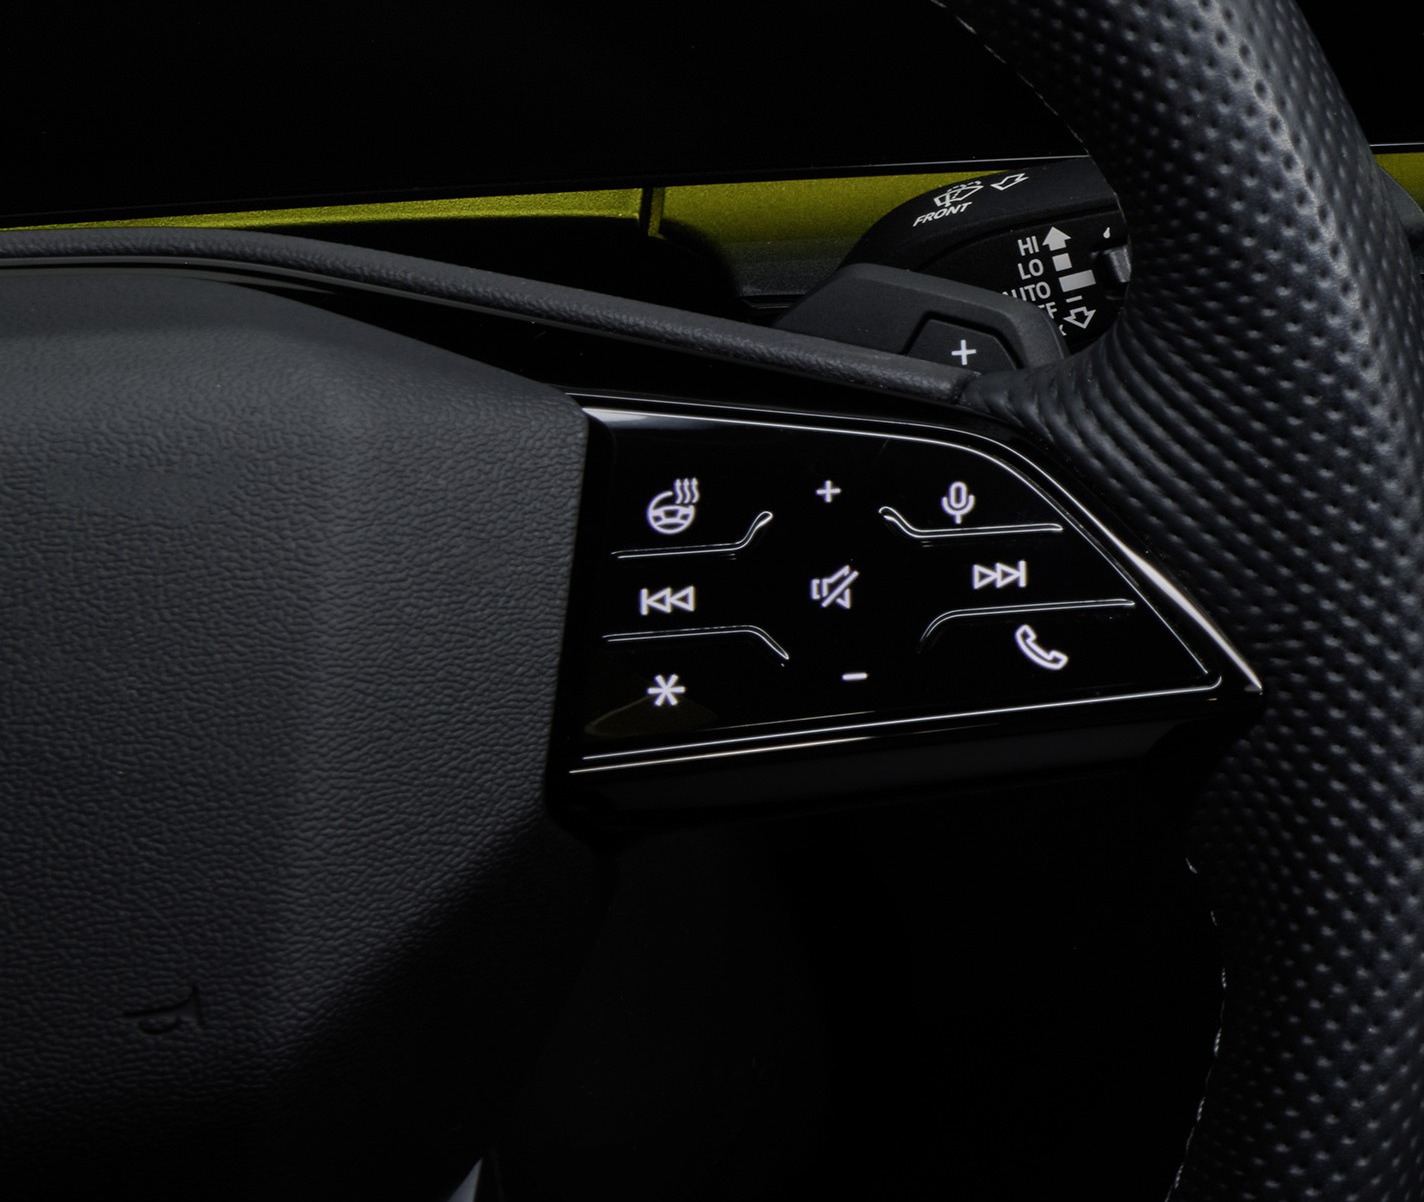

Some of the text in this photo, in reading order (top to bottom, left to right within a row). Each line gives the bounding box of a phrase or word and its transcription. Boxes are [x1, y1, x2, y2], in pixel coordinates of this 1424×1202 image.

[912, 202, 973, 227] FRONT
[1018, 235, 1040, 256] HI
[1018, 258, 1044, 280] LO
